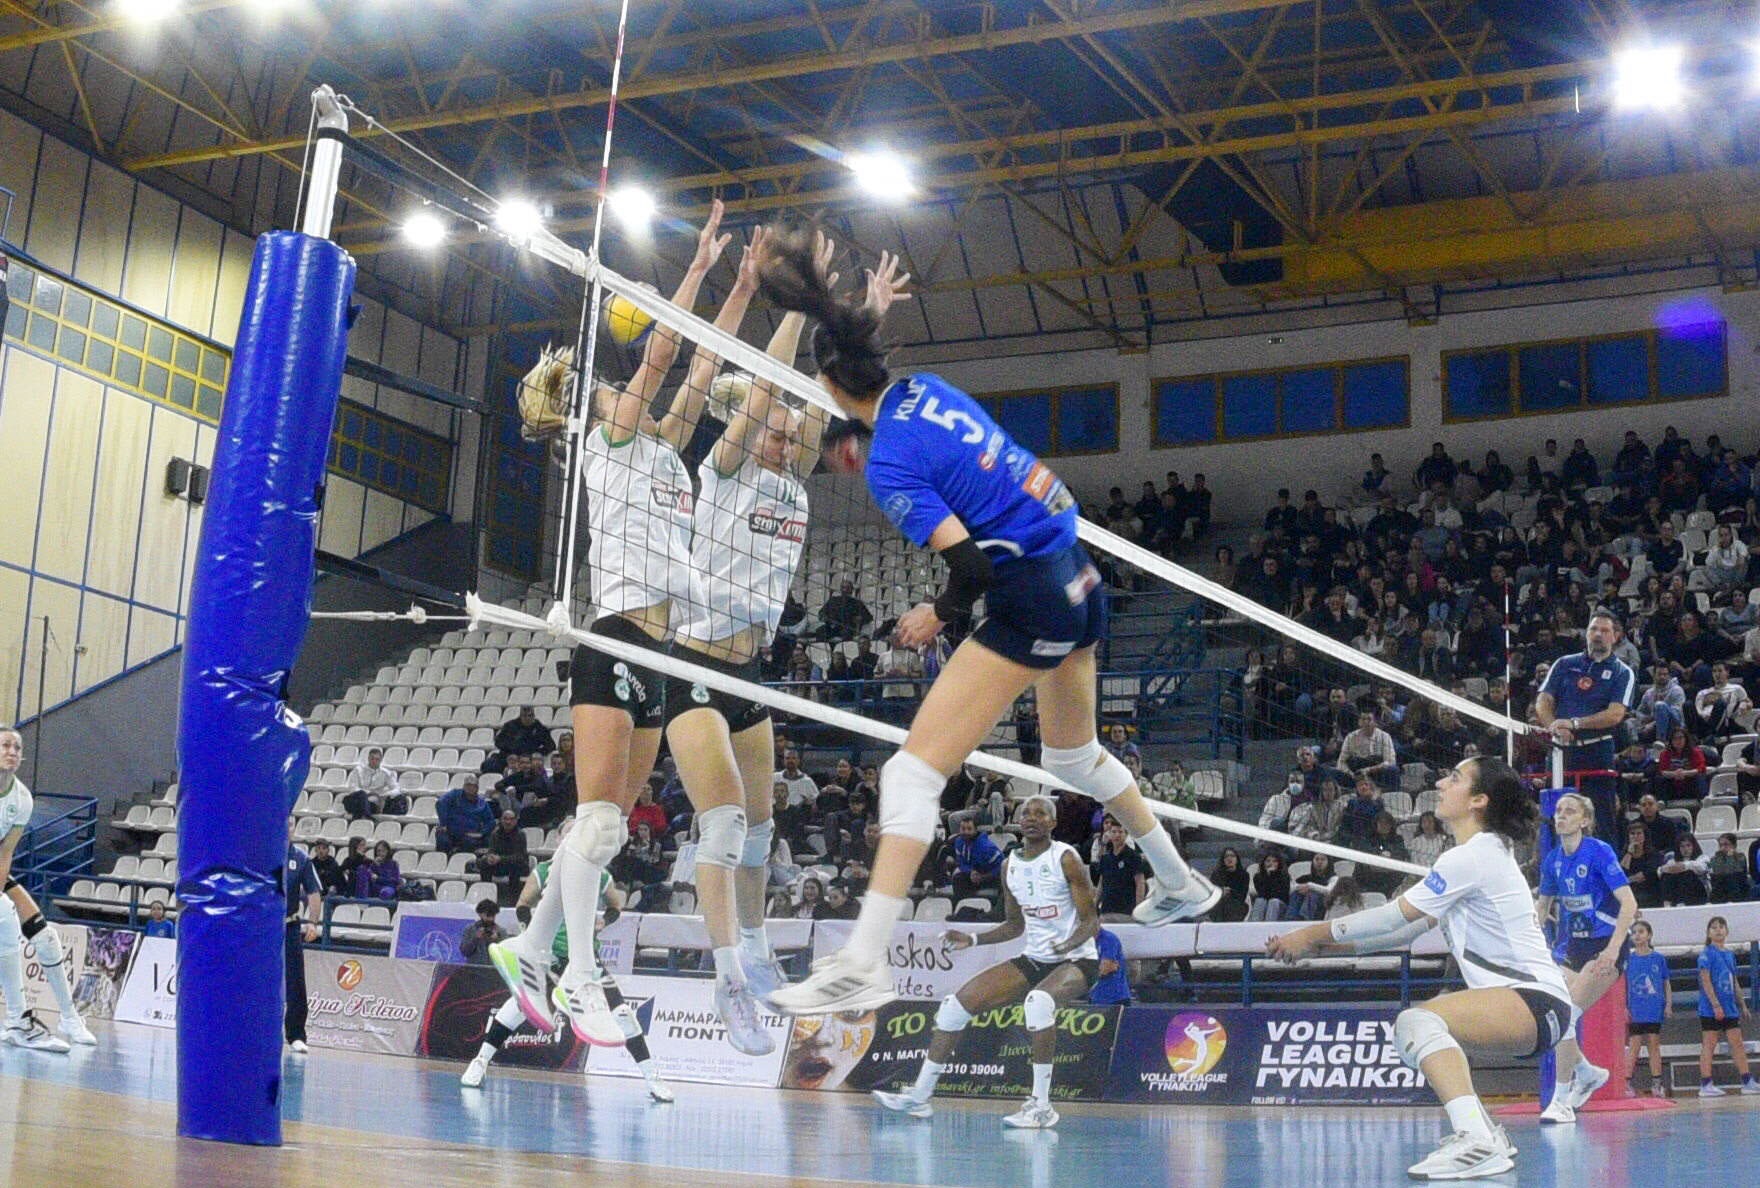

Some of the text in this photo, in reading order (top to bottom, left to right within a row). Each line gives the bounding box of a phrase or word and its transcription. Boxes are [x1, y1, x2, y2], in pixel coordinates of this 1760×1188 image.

[920, 396, 984, 444] 5
[1027, 880, 1034, 896] 3
[891, 975, 933, 997] ites
[668, 1026, 729, 1041] ΠΟΝΤ
[1267, 1021, 1396, 1042] VOLLEY
[896, 1049, 929, 1061] ΜΑΓΝ
[1260, 1044, 1401, 1065] LEAGUE
[970, 1064, 1005, 1076] 39004
